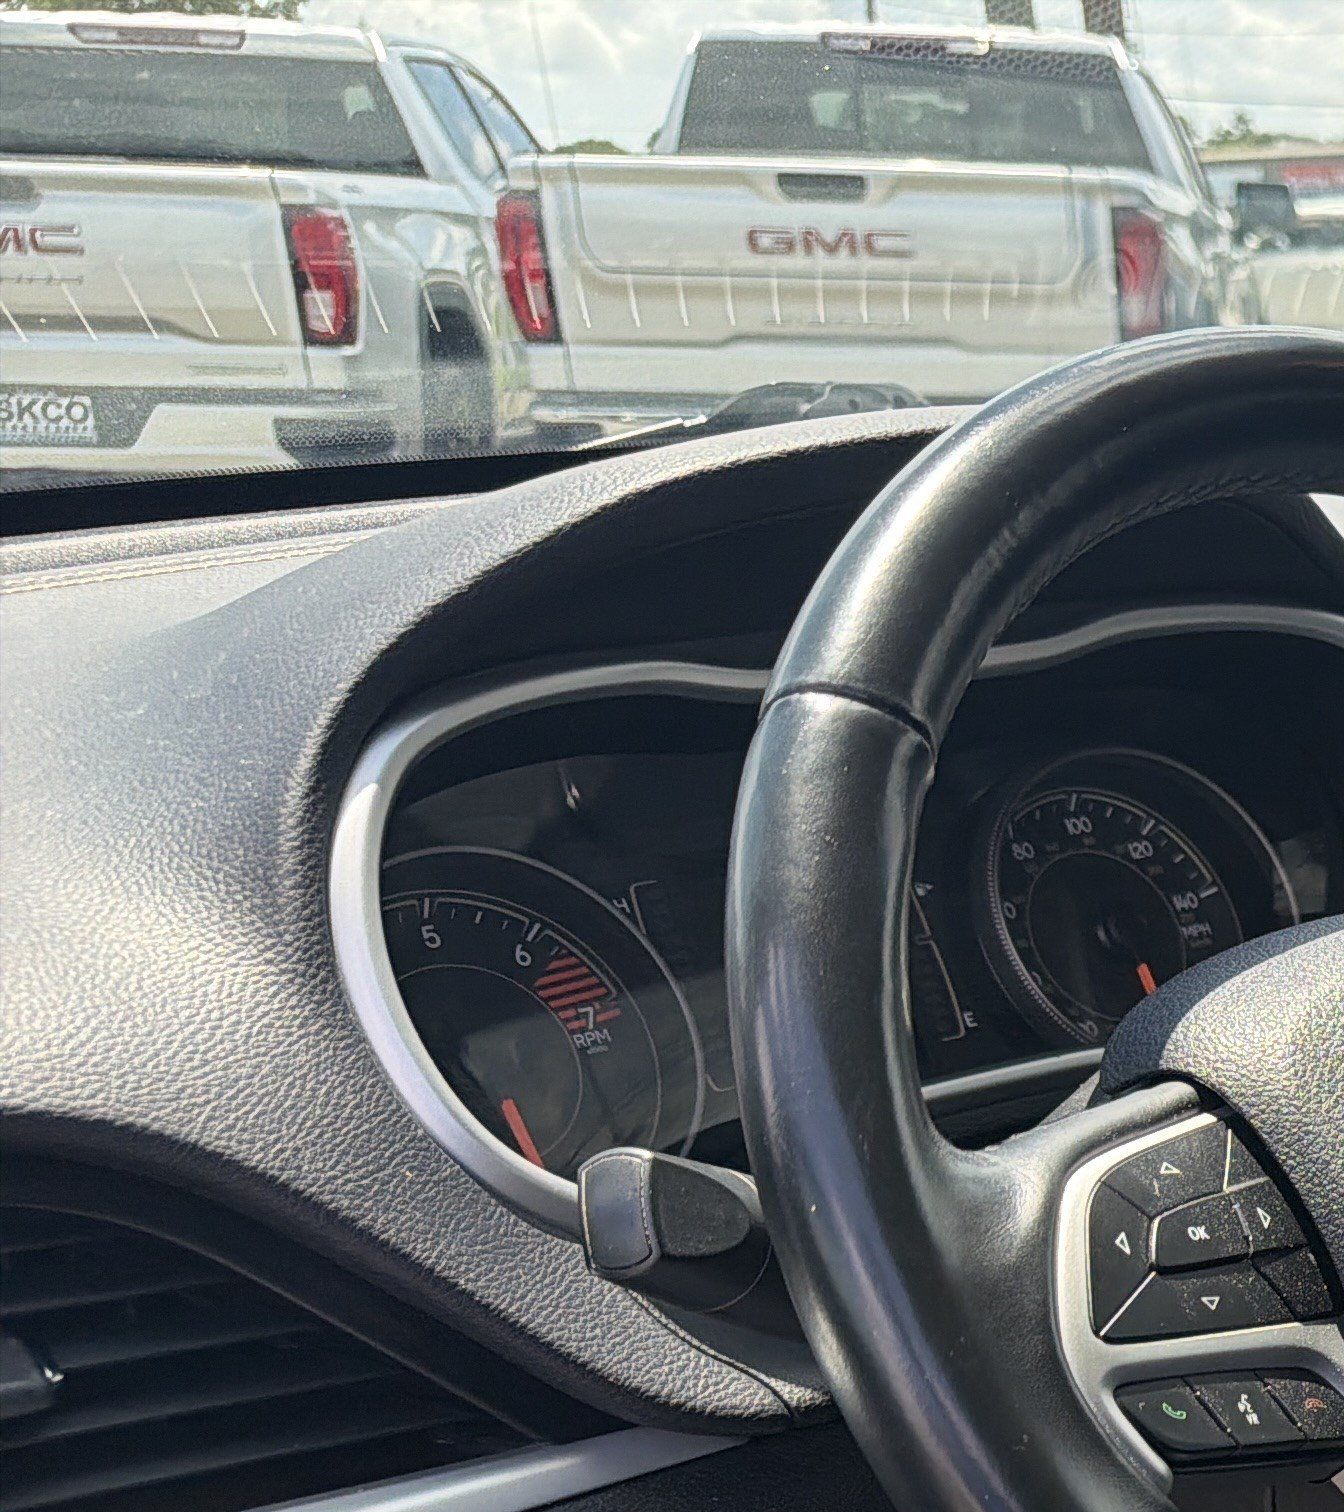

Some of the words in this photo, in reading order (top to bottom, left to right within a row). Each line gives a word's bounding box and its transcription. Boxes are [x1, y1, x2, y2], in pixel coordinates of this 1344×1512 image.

[747, 227, 915, 259] GMC
[1063, 816, 1092, 834] 100
[1011, 842, 1034, 861] 80
[421, 924, 442, 949] 5
[515, 944, 532, 967] 6
[577, 1006, 594, 1029] 7
[964, 1011, 979, 1028] E
[572, 1028, 612, 1049] RPM
[1187, 1225, 1211, 1242] OK
